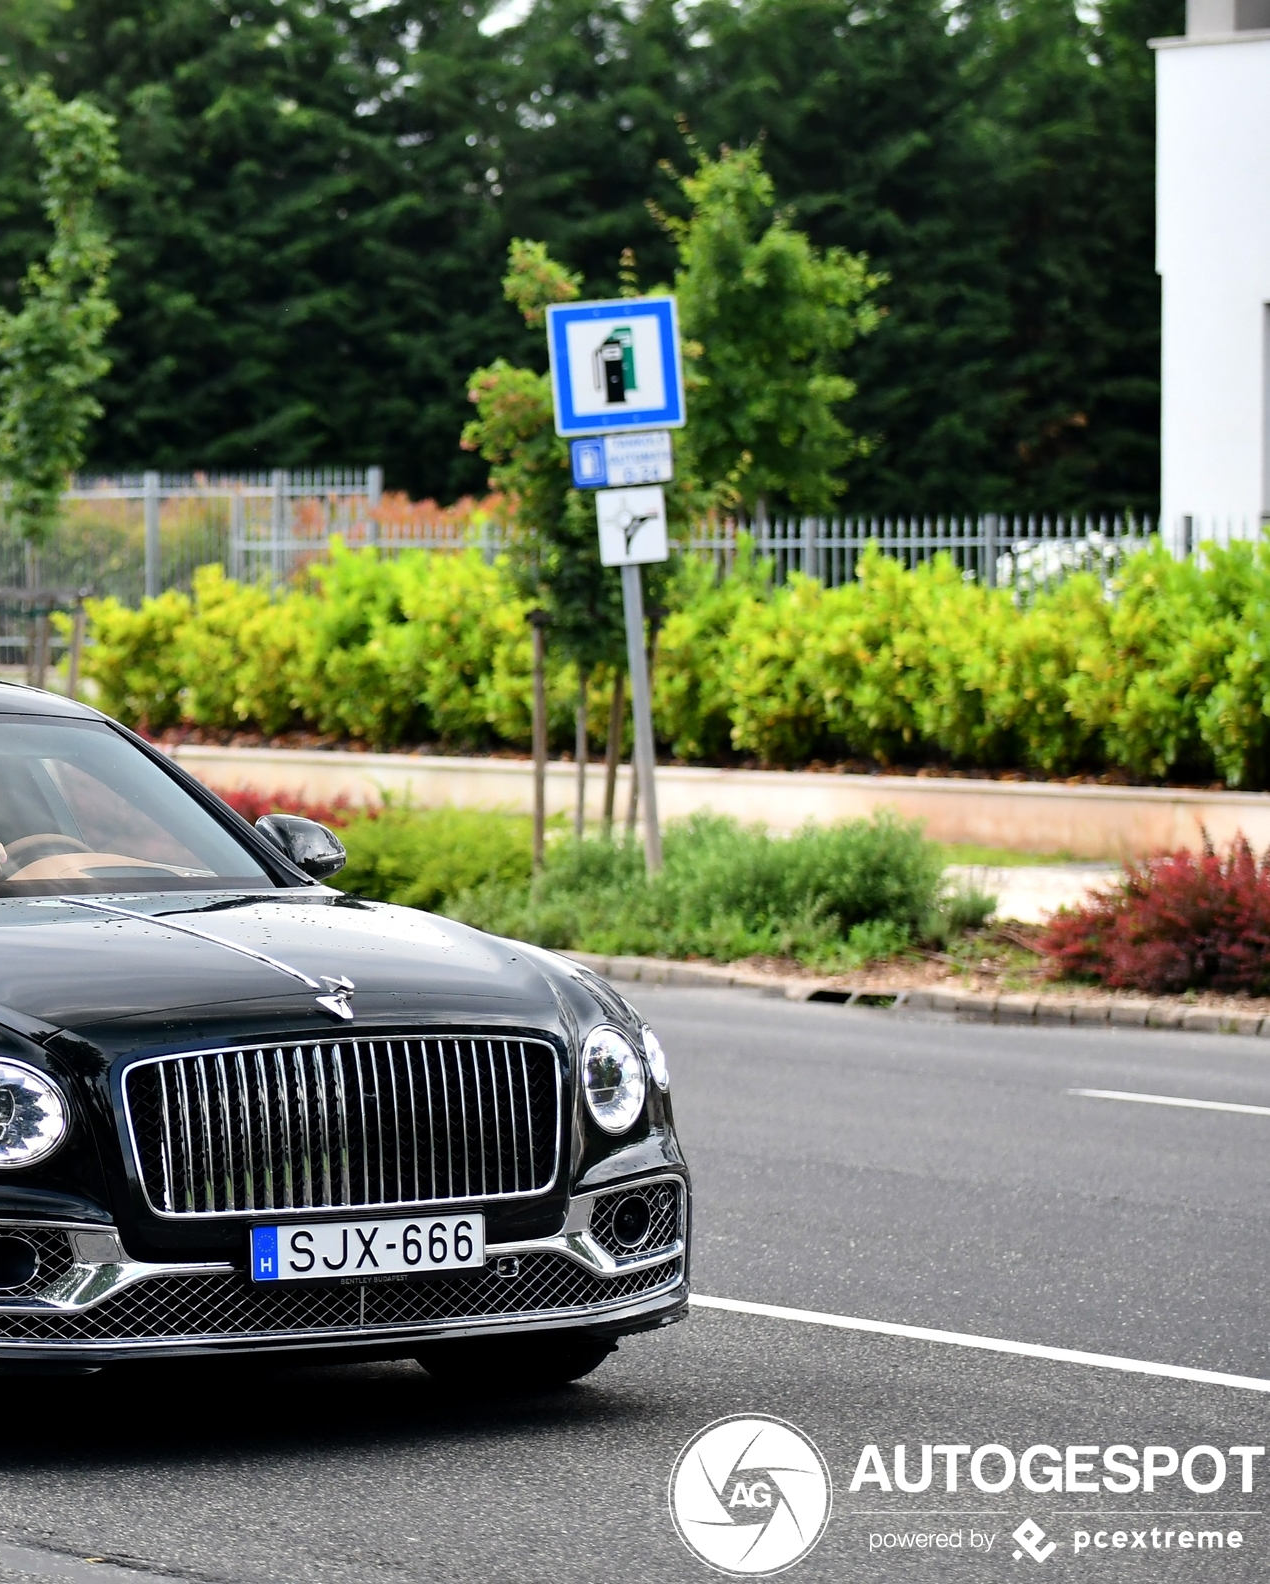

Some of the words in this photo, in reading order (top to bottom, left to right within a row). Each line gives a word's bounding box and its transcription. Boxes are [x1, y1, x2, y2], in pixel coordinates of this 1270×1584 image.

[289, 1220, 473, 1272] SJX-666
[260, 1257, 272, 1273] H
[340, 1277, 372, 1285] BENTLEY
[373, 1274, 408, 1283] BUDAPEST
